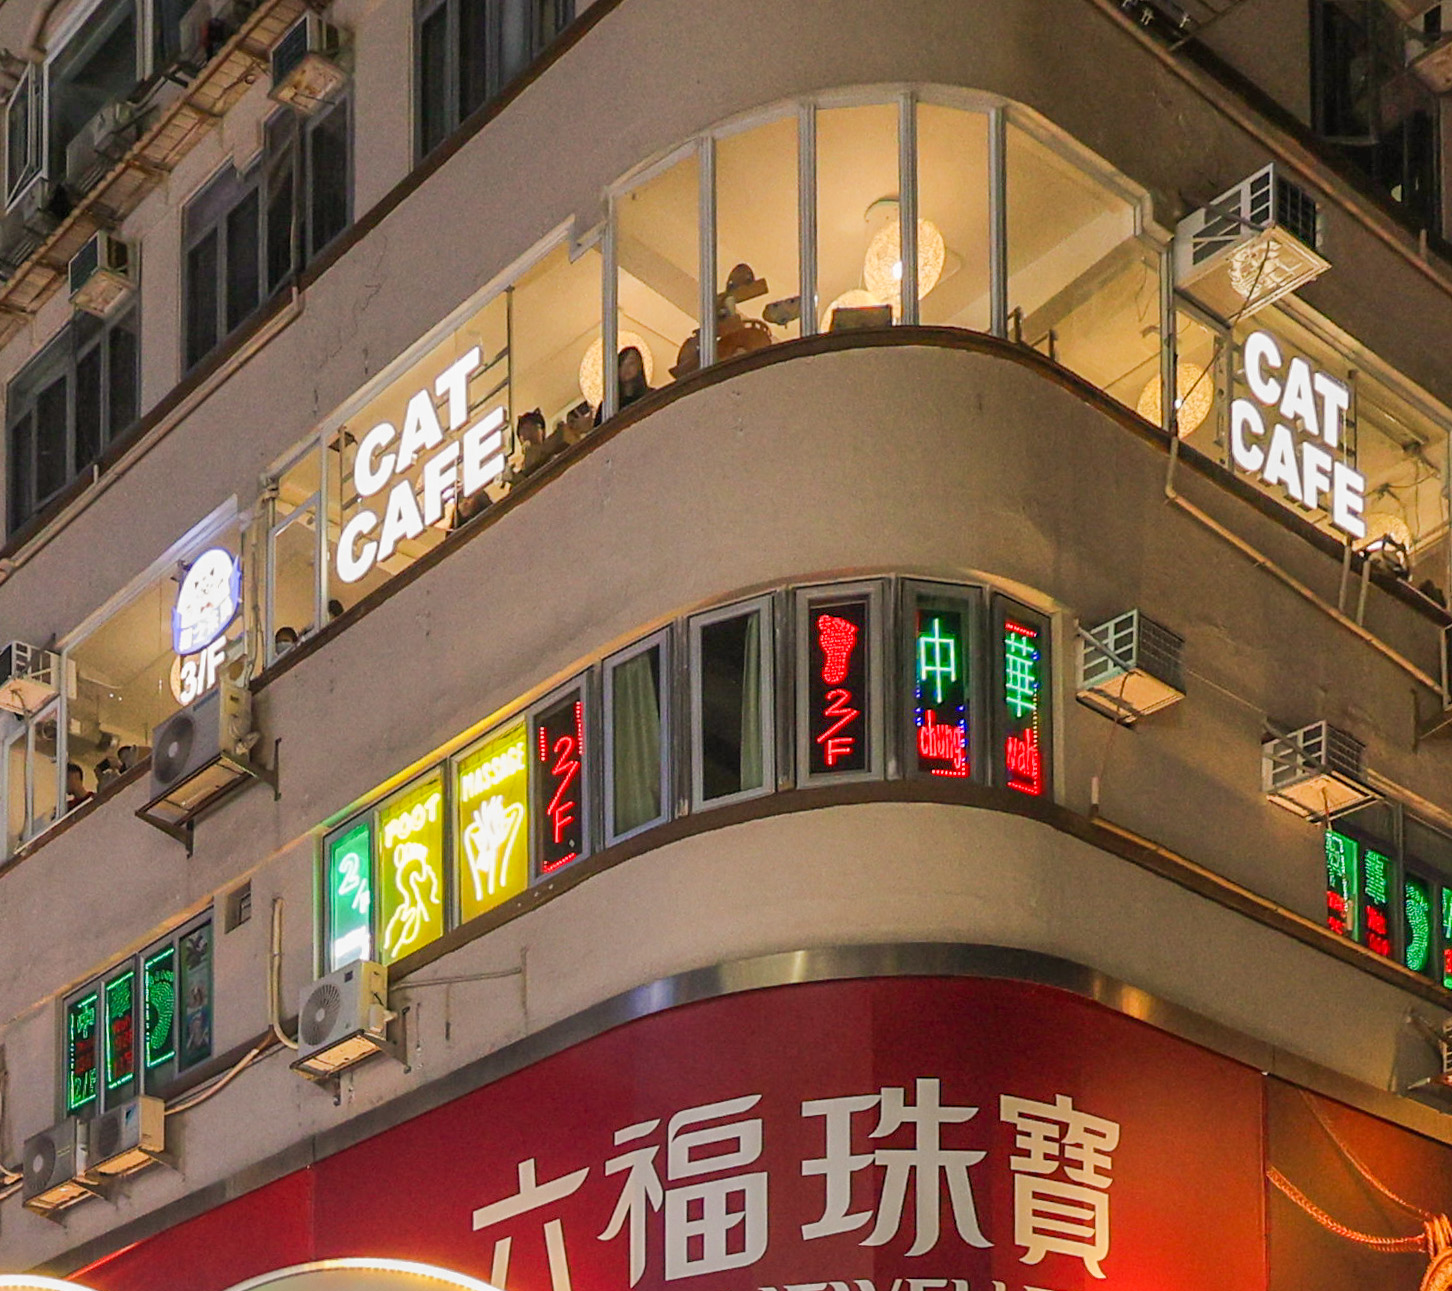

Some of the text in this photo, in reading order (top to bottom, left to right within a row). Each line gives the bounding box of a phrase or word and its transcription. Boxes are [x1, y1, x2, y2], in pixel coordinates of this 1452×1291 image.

[354, 346, 481, 498] CAT
[1244, 331, 1349, 448] CAT
[336, 405, 506, 583] CAFE
[1231, 399, 1366, 538] CAFE
[179, 635, 228, 706] 3/F
[919, 617, 958, 703] 中
[817, 689, 860, 766] 2/F
[384, 792, 442, 848] FOOT
[546, 736, 581, 843] 2/F
